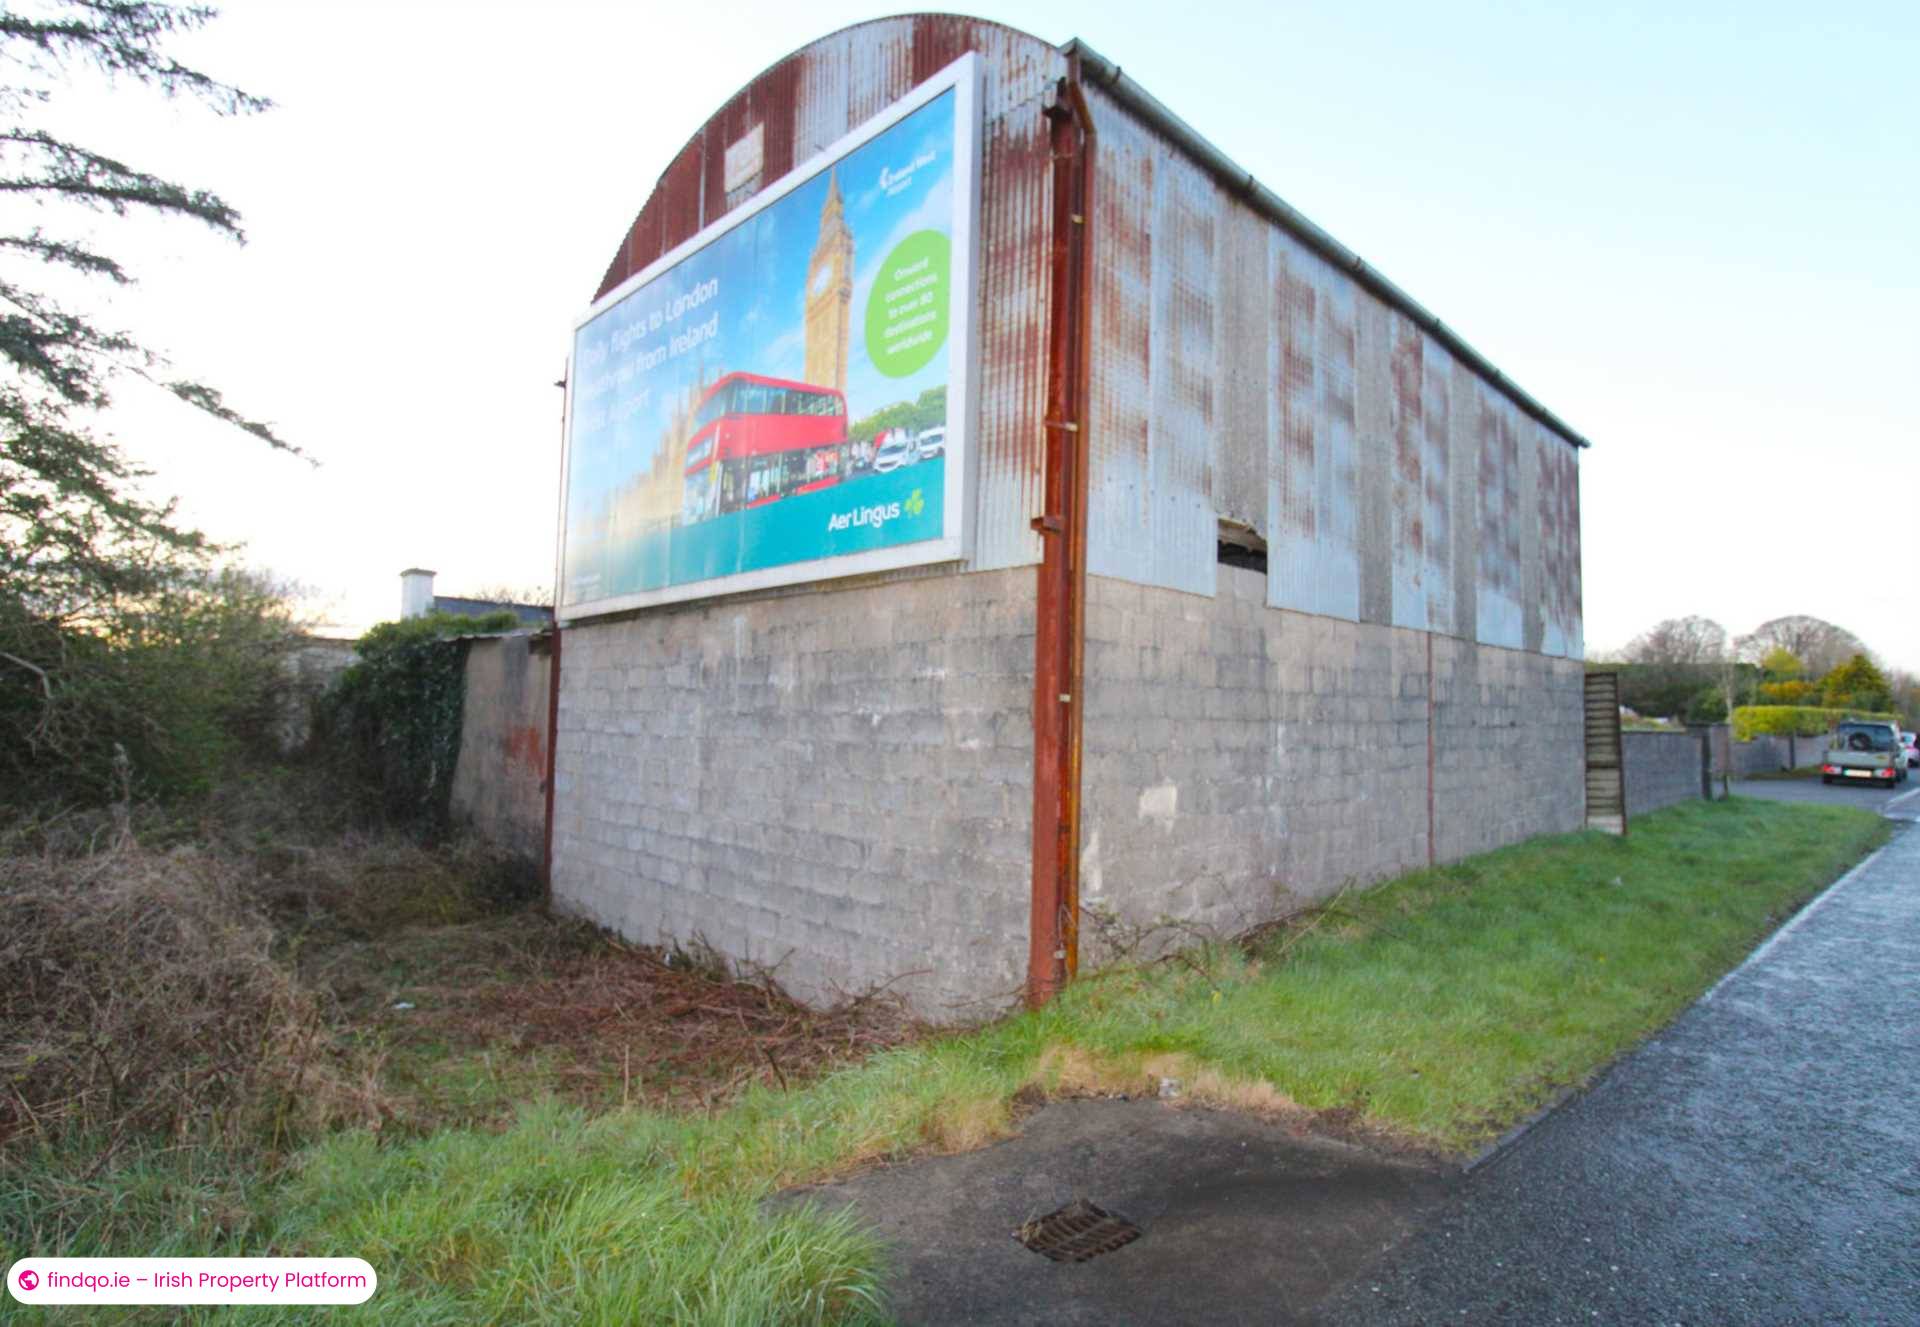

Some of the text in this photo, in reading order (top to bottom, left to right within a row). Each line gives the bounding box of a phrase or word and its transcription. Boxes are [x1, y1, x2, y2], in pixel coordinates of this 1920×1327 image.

[611, 319, 648, 353] flights
[648, 310, 664, 331] to
[666, 278, 719, 320] London
[636, 312, 719, 375] from Ireland
